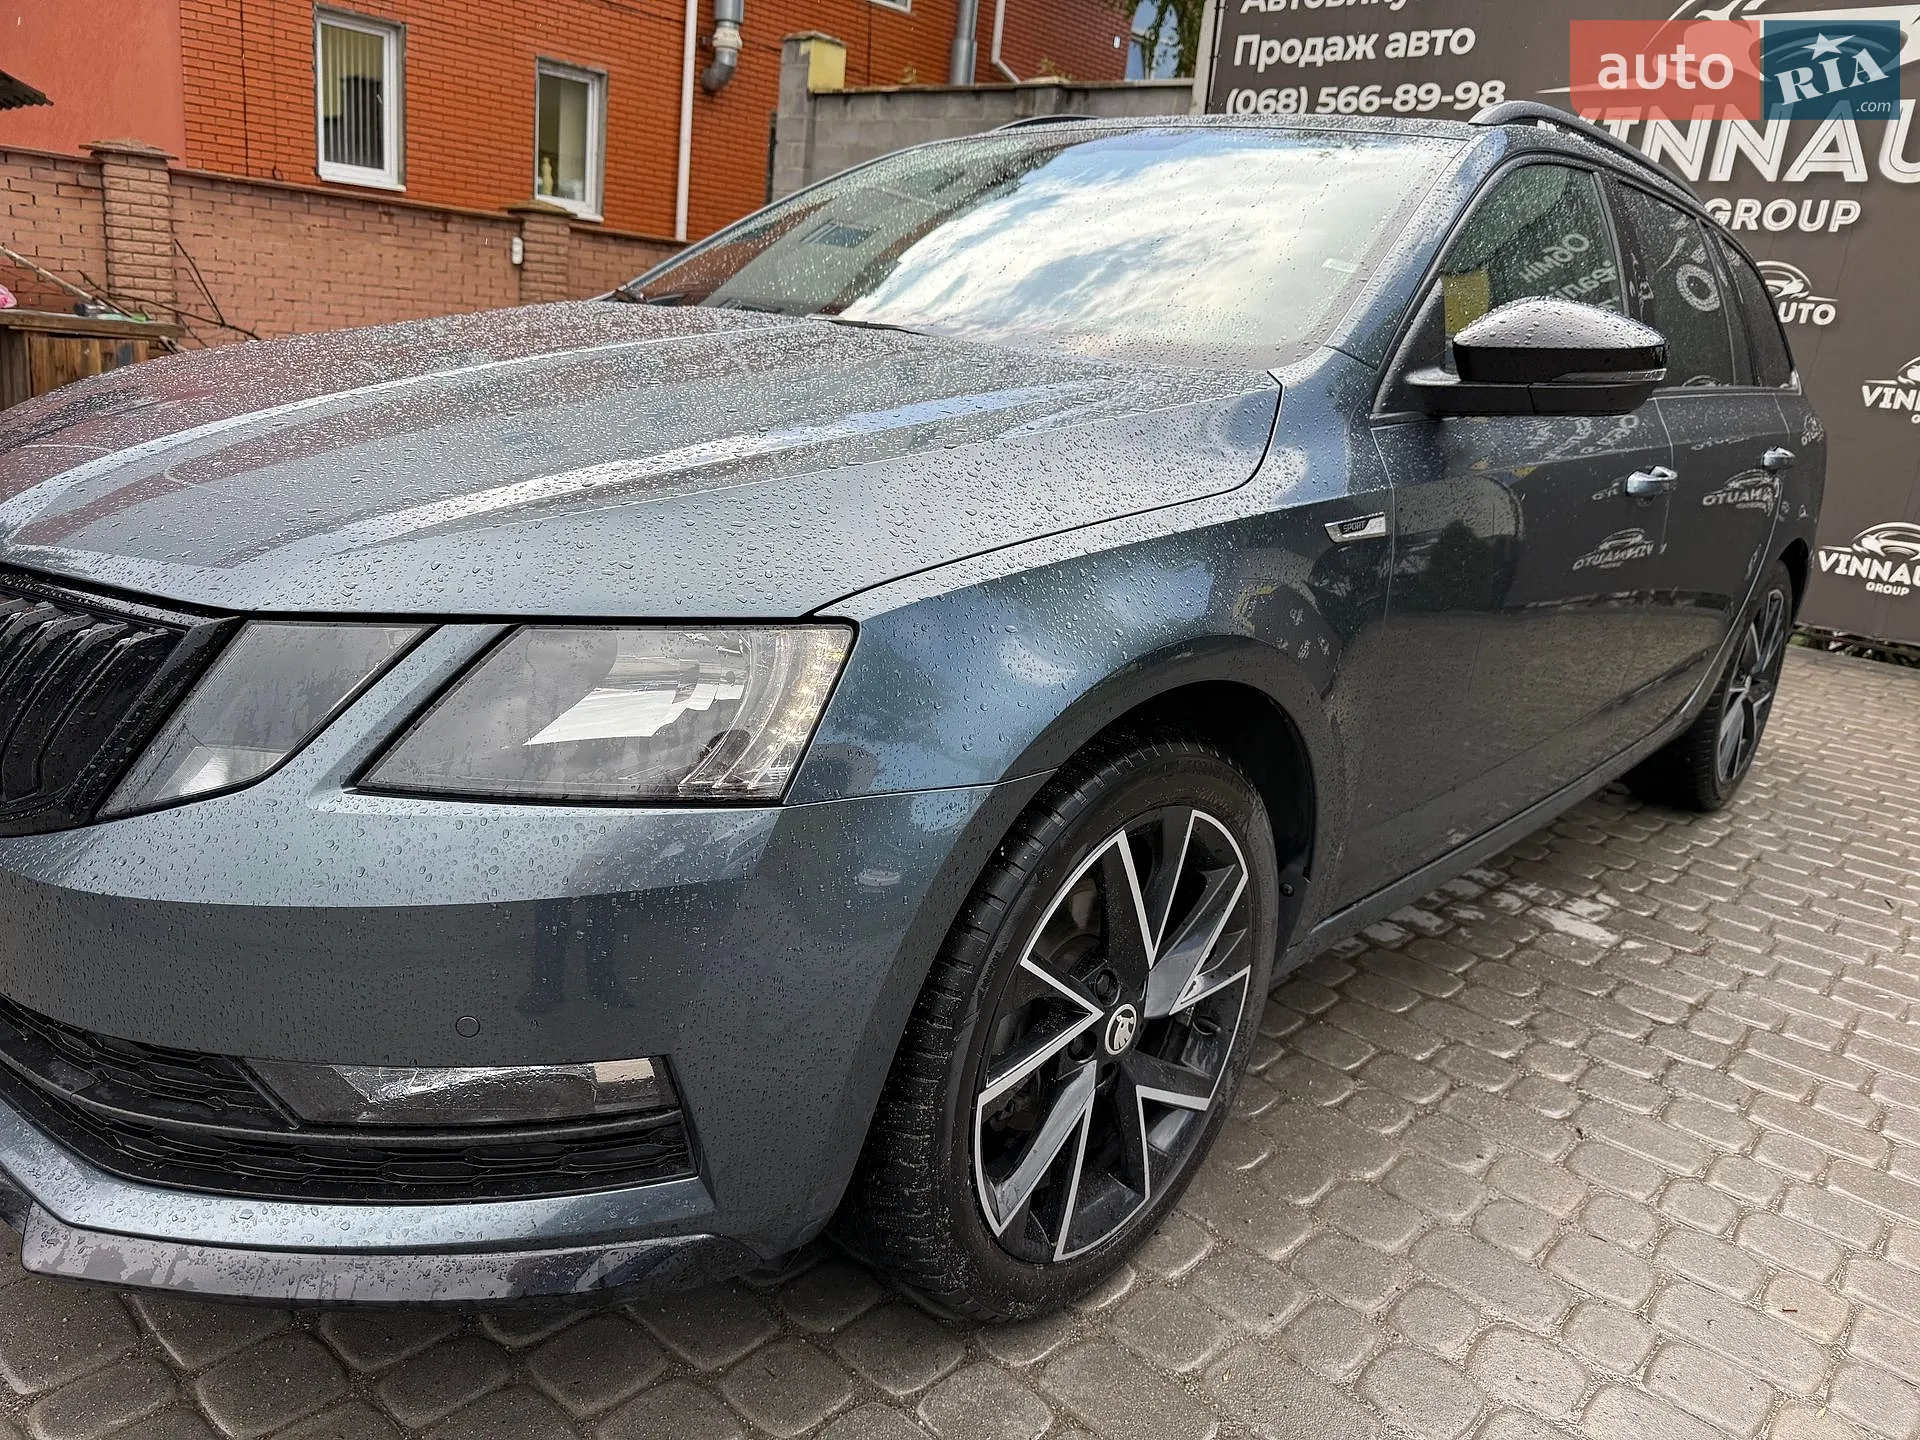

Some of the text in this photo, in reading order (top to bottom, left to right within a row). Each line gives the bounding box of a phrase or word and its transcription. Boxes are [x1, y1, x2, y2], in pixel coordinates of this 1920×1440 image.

[1234, 28, 1476, 73] Продаж авто
[1226, 80, 1506, 114] (068) 566-89-98
[1703, 198, 1862, 233] GROUP
[1866, 581, 1910, 596] GROUP
